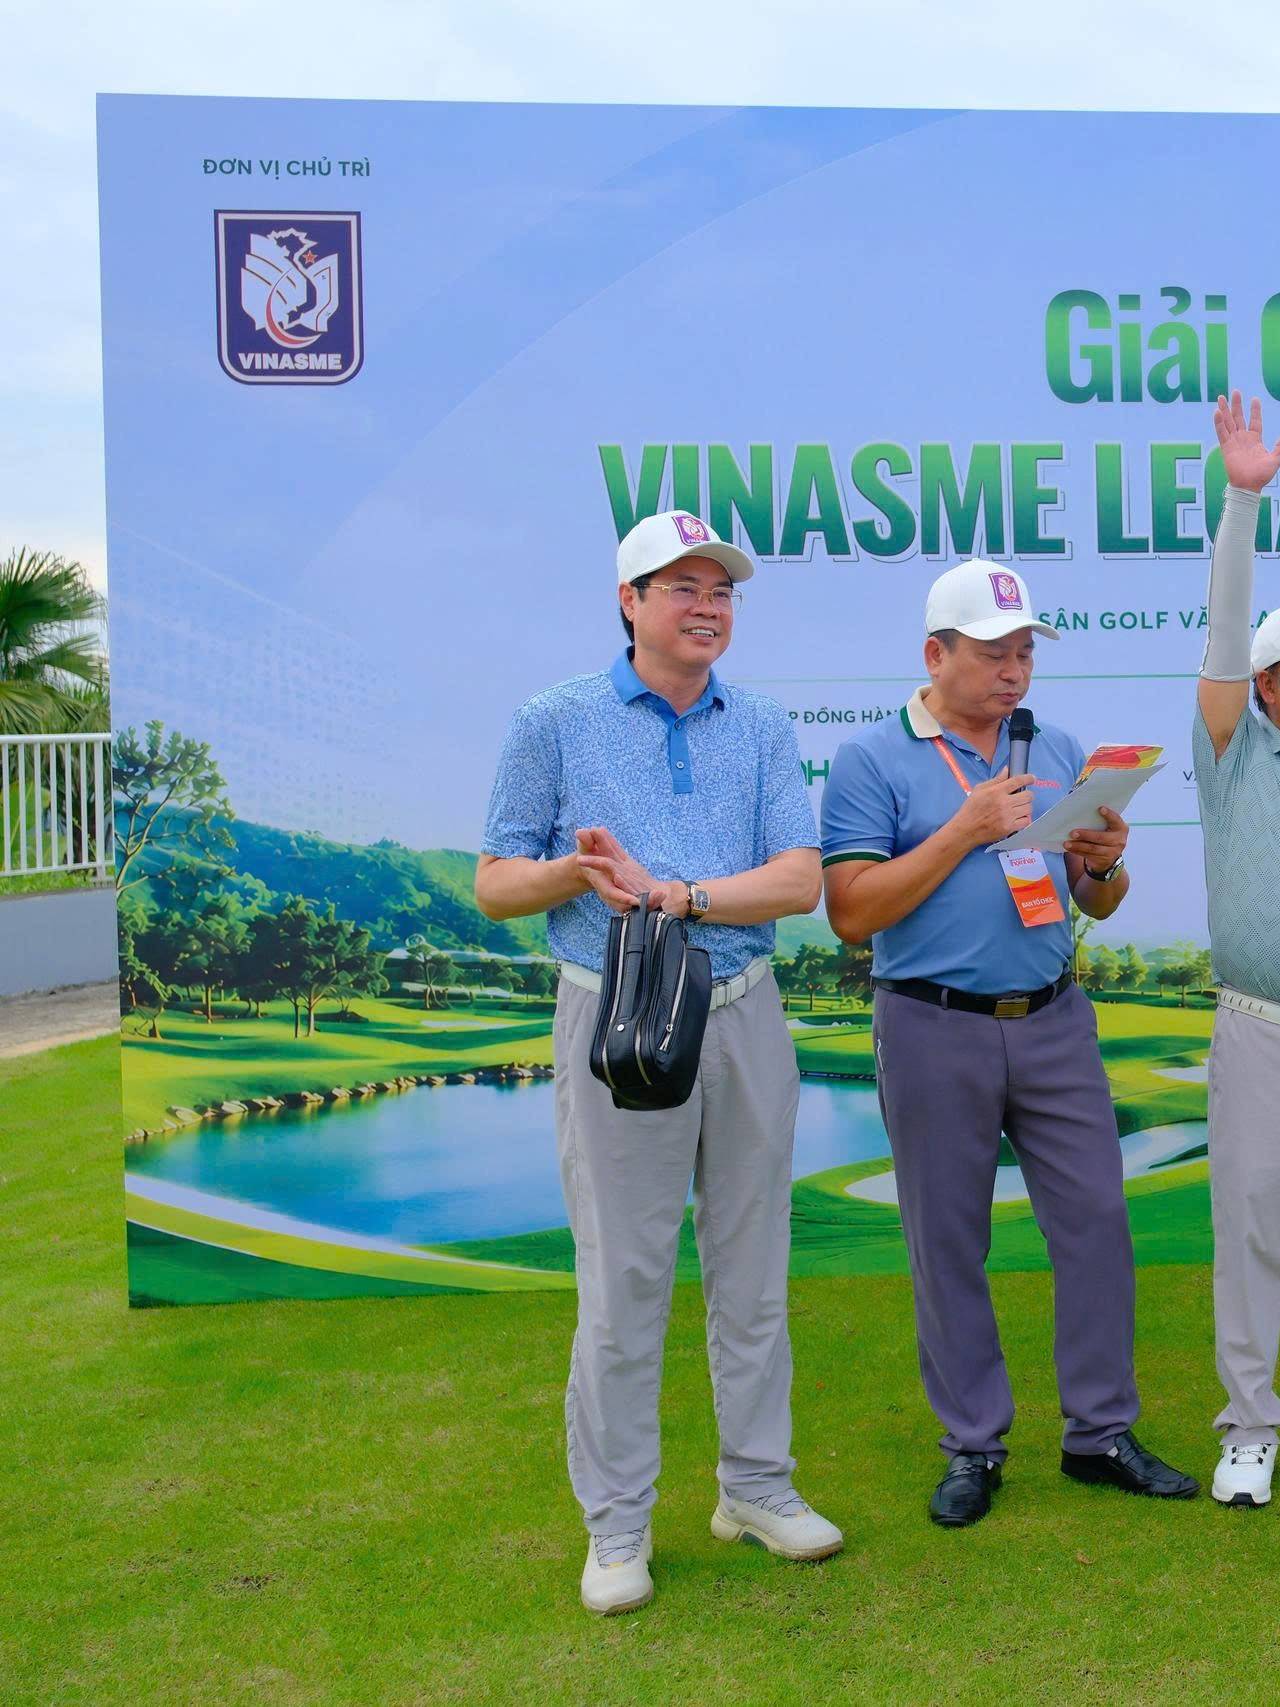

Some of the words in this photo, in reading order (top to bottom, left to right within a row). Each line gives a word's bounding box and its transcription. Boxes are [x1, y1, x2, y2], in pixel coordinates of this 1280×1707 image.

[203, 158, 251, 175] ĐƠN
[259, 160, 280, 180] VỊ
[286, 156, 332, 176] CHỦ
[338, 157, 371, 177] TRÌ
[1045, 286, 1228, 405] Giải
[238, 352, 342, 371] VINASME
[597, 442, 1070, 558] VINASME
[1038, 607, 1089, 630] SÂN
[1099, 611, 1169, 630] GOLF
[1179, 606, 1207, 629] VĂ
[803, 706, 856, 724] ĐỒNG
